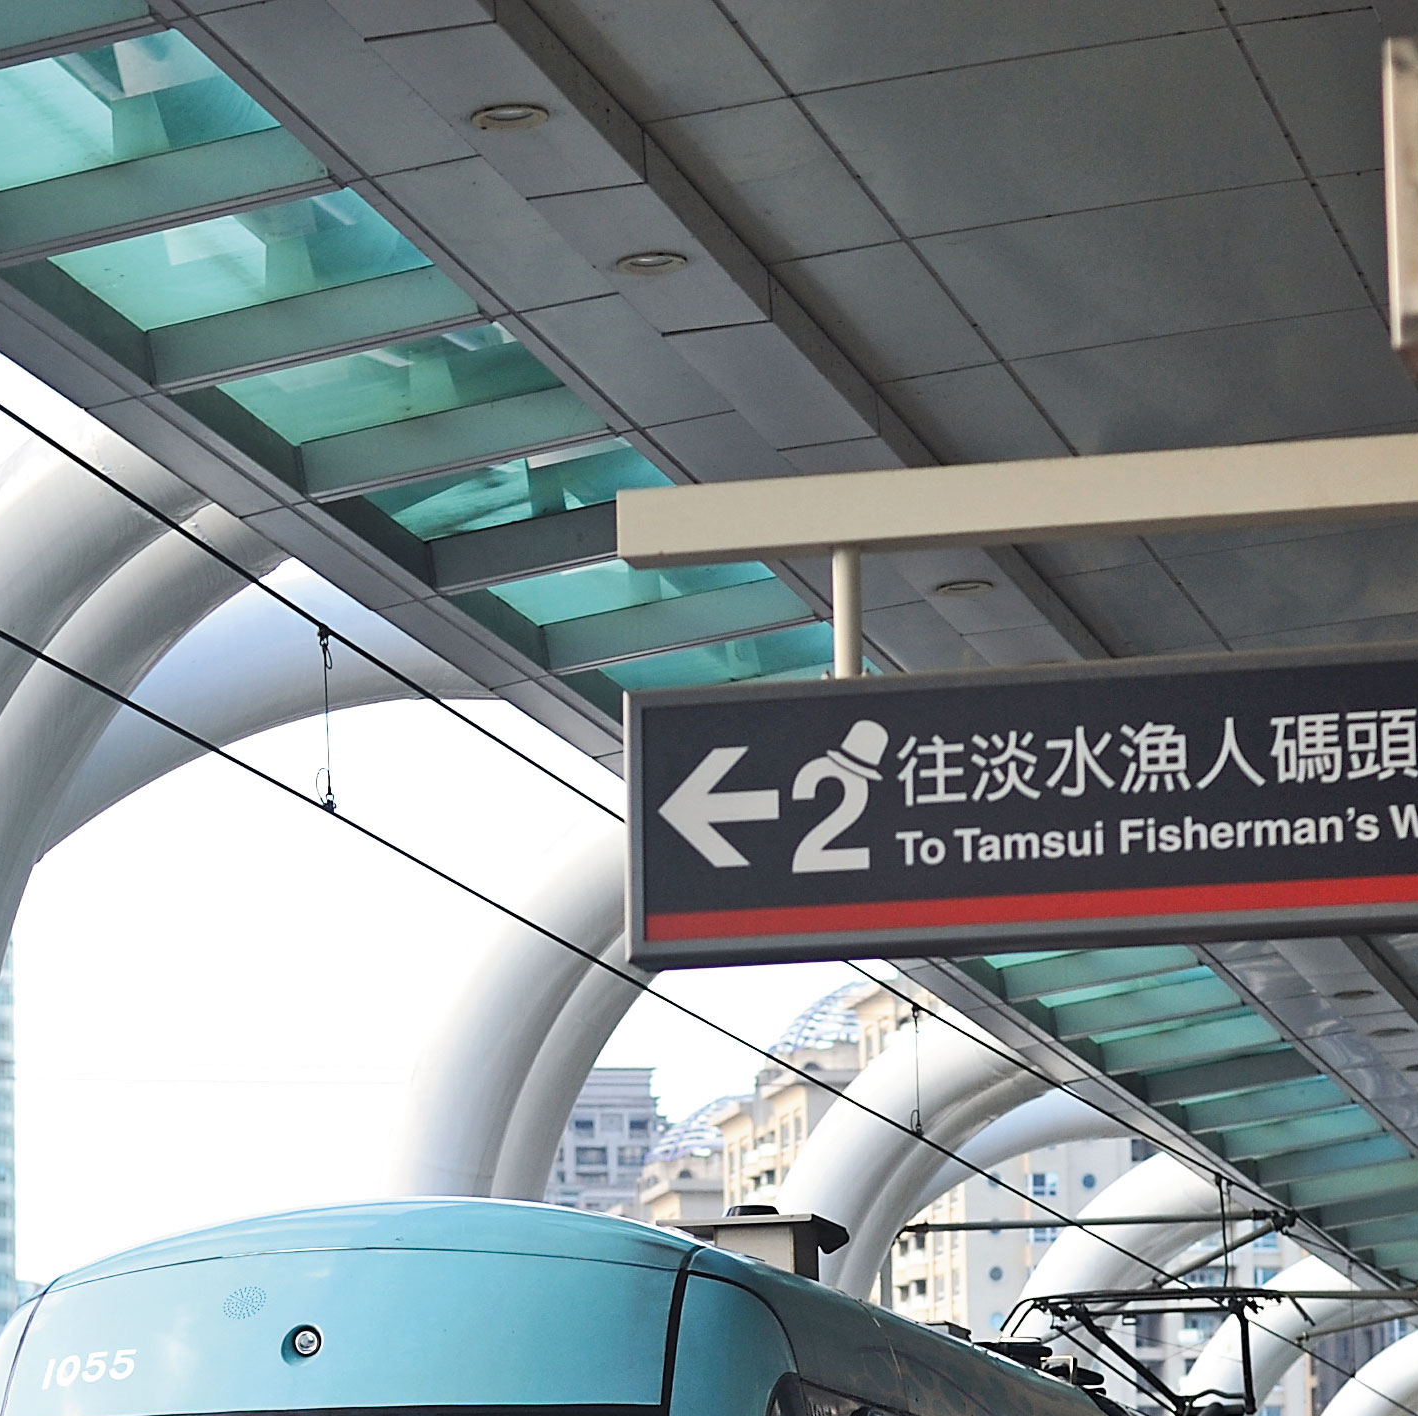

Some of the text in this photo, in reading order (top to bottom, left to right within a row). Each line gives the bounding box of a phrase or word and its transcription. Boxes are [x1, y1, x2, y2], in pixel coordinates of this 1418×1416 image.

[895, 830, 946, 866] To
[952, 820, 1105, 863] Tamsui
[1119, 806, 1380, 855] Fisherman’s
[41, 1348, 137, 1391] 1055
